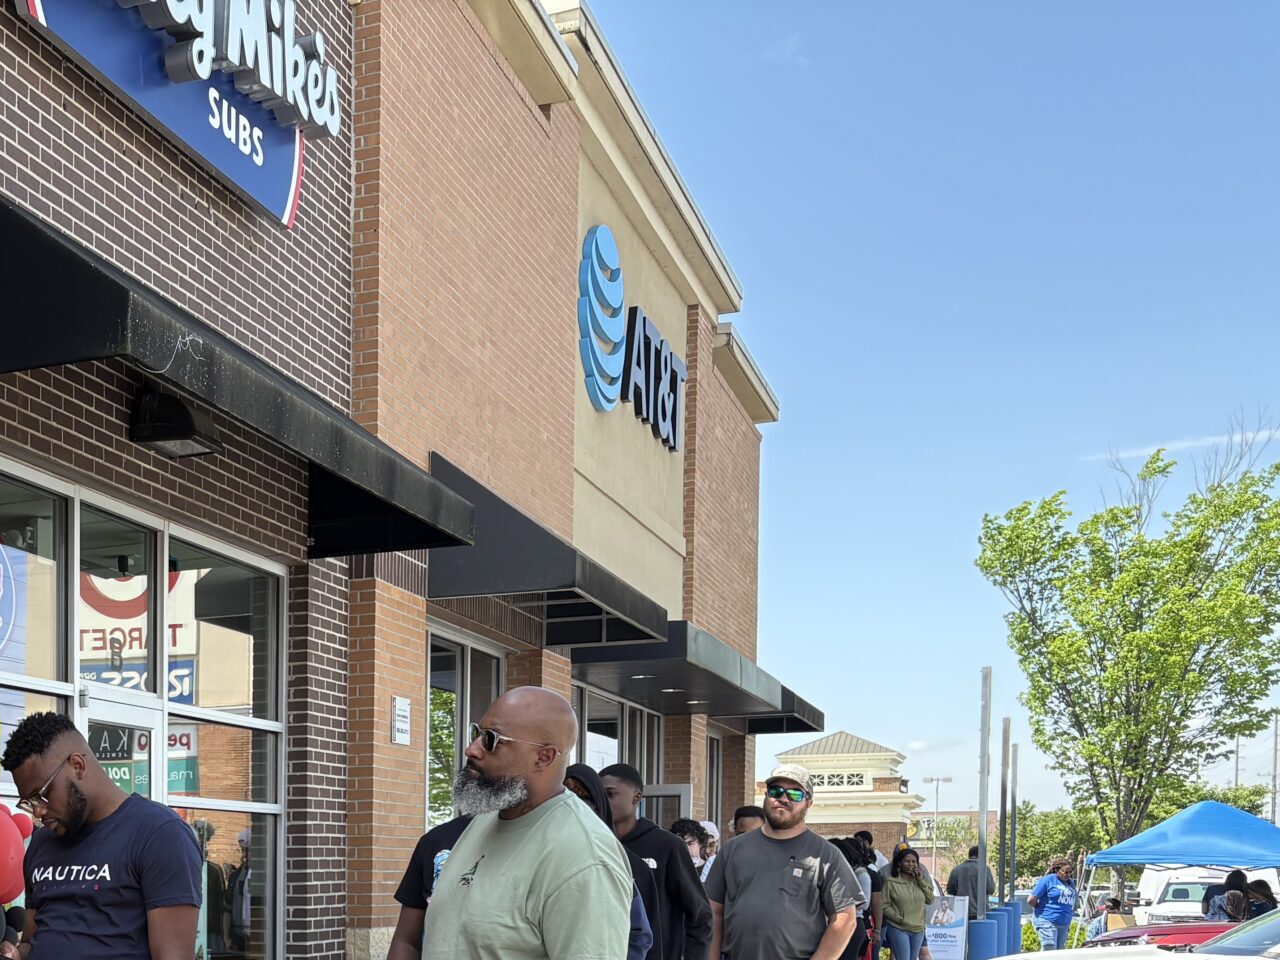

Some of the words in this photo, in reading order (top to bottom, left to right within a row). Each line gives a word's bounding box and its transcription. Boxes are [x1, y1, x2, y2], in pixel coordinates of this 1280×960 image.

[208, 86, 264, 167] SUBS
[624, 305, 688, 453] AT&T
[32, 863, 111, 884] NAUTICA
